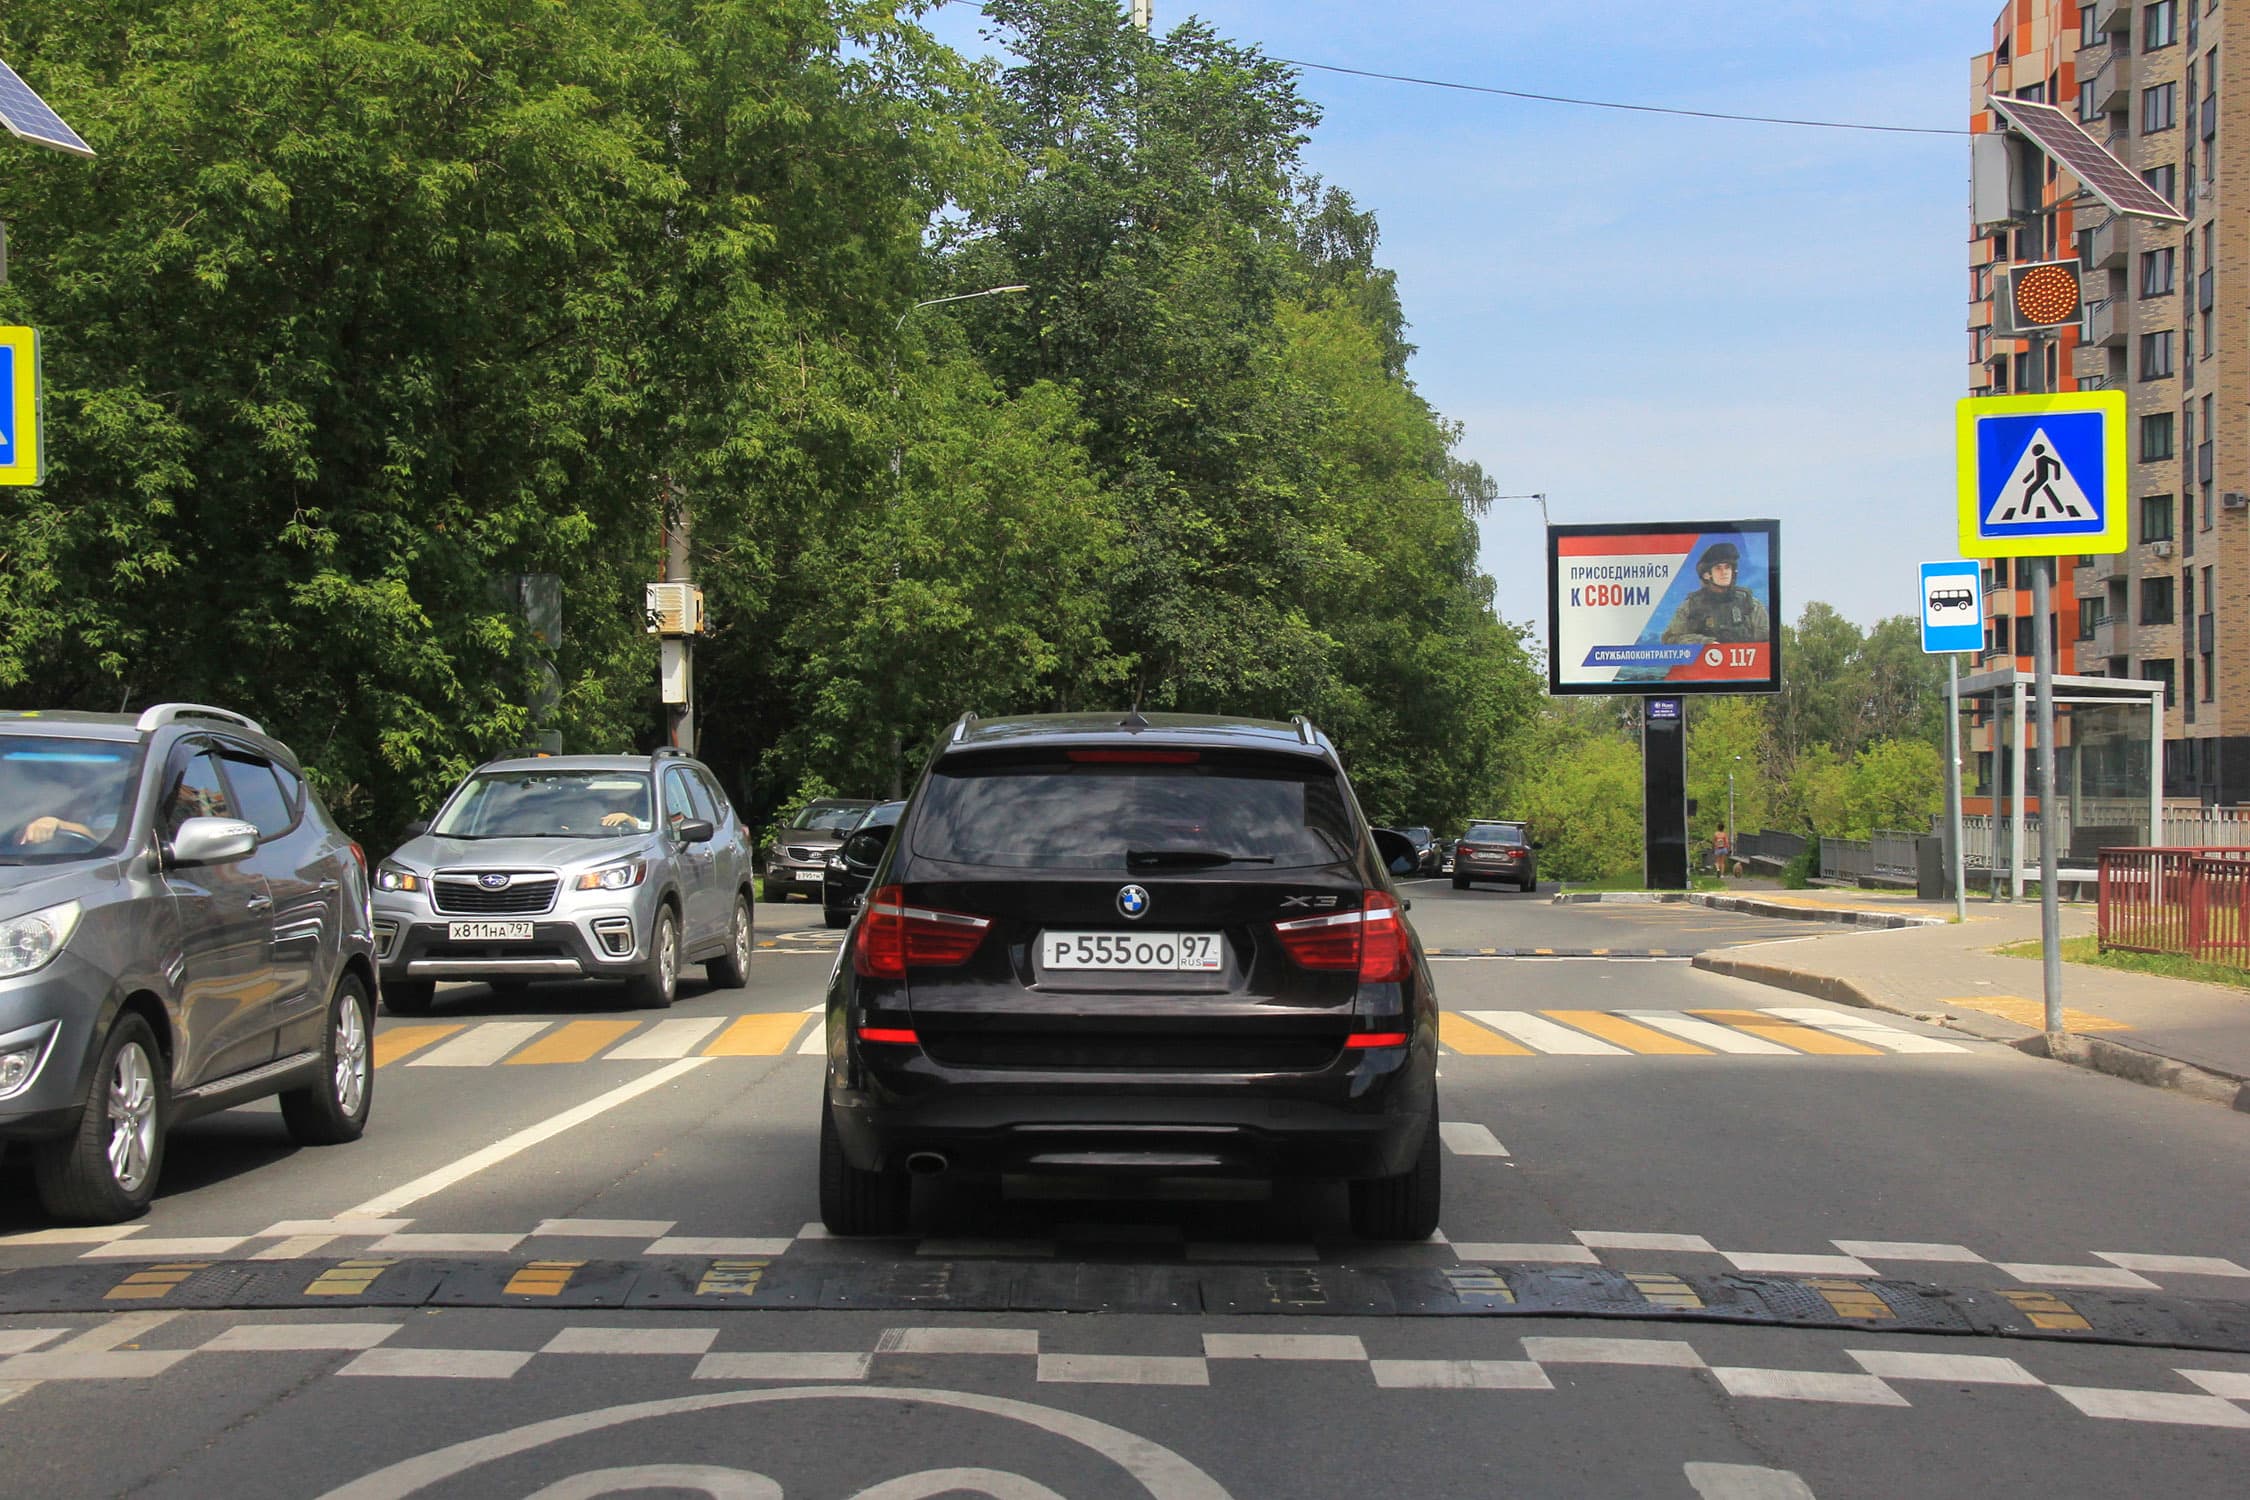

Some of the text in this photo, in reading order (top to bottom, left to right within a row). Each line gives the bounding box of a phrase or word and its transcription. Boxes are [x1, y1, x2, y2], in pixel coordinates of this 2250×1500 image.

[1570, 563, 1669, 580] ПРИСОЕДИНЯЙСЯ
[1571, 588, 1581, 607] К
[1595, 649, 1691, 661] СЛУЖБАПОКОНТРАКТУ.РФ
[1729, 648, 1756, 667] 117
[1280, 895, 1338, 908] X3
[510, 923, 530, 934] 797
[1182, 936, 1211, 958] 97
[1180, 958, 1202, 967] RUS
